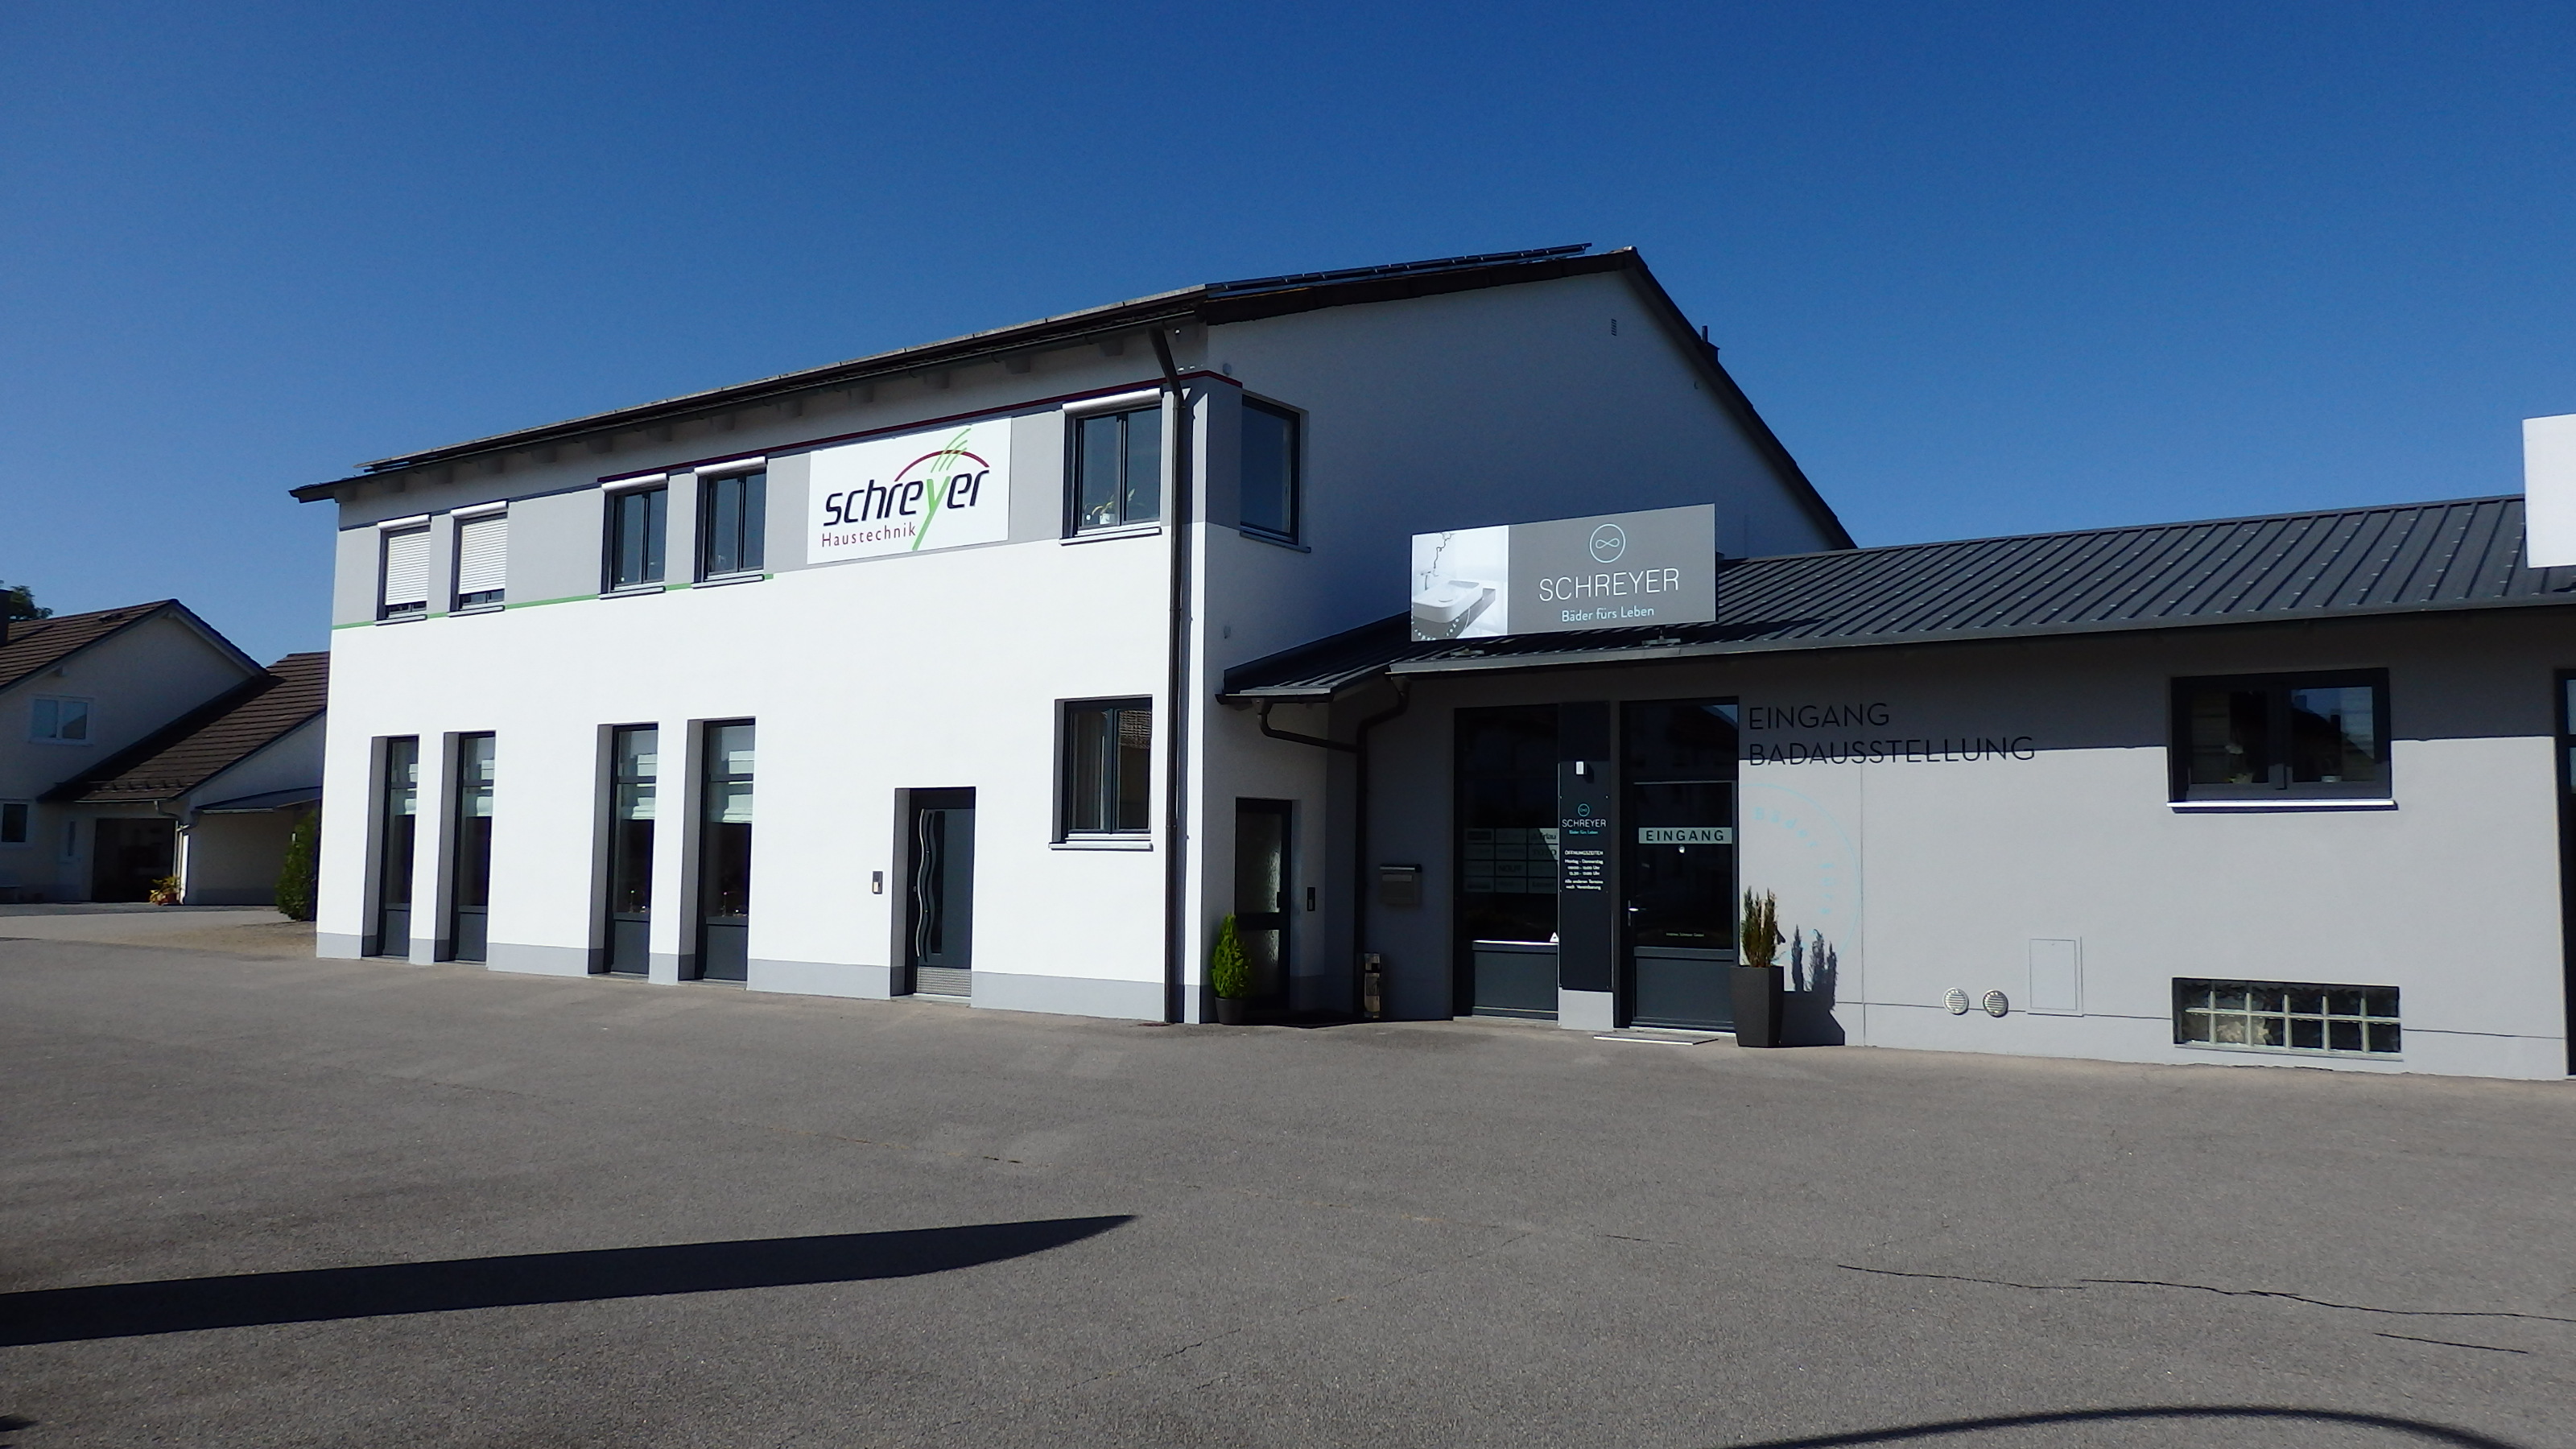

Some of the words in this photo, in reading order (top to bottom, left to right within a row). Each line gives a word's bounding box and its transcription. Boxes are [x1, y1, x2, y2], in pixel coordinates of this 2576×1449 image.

[823, 469, 989, 551] schreyer
[821, 522, 916, 547] Haustechnik
[1538, 568, 1680, 602] SCHREYER
[1561, 607, 1594, 622] Bäder
[1596, 607, 1618, 620] fürs
[1620, 605, 1654, 618] Leben
[1749, 702, 1890, 730] EINGANG
[1748, 736, 2036, 766] BADAUSSTELLUNG
[1562, 819, 1607, 828] SCHREYER
[1645, 829, 1724, 841] EINGANG
